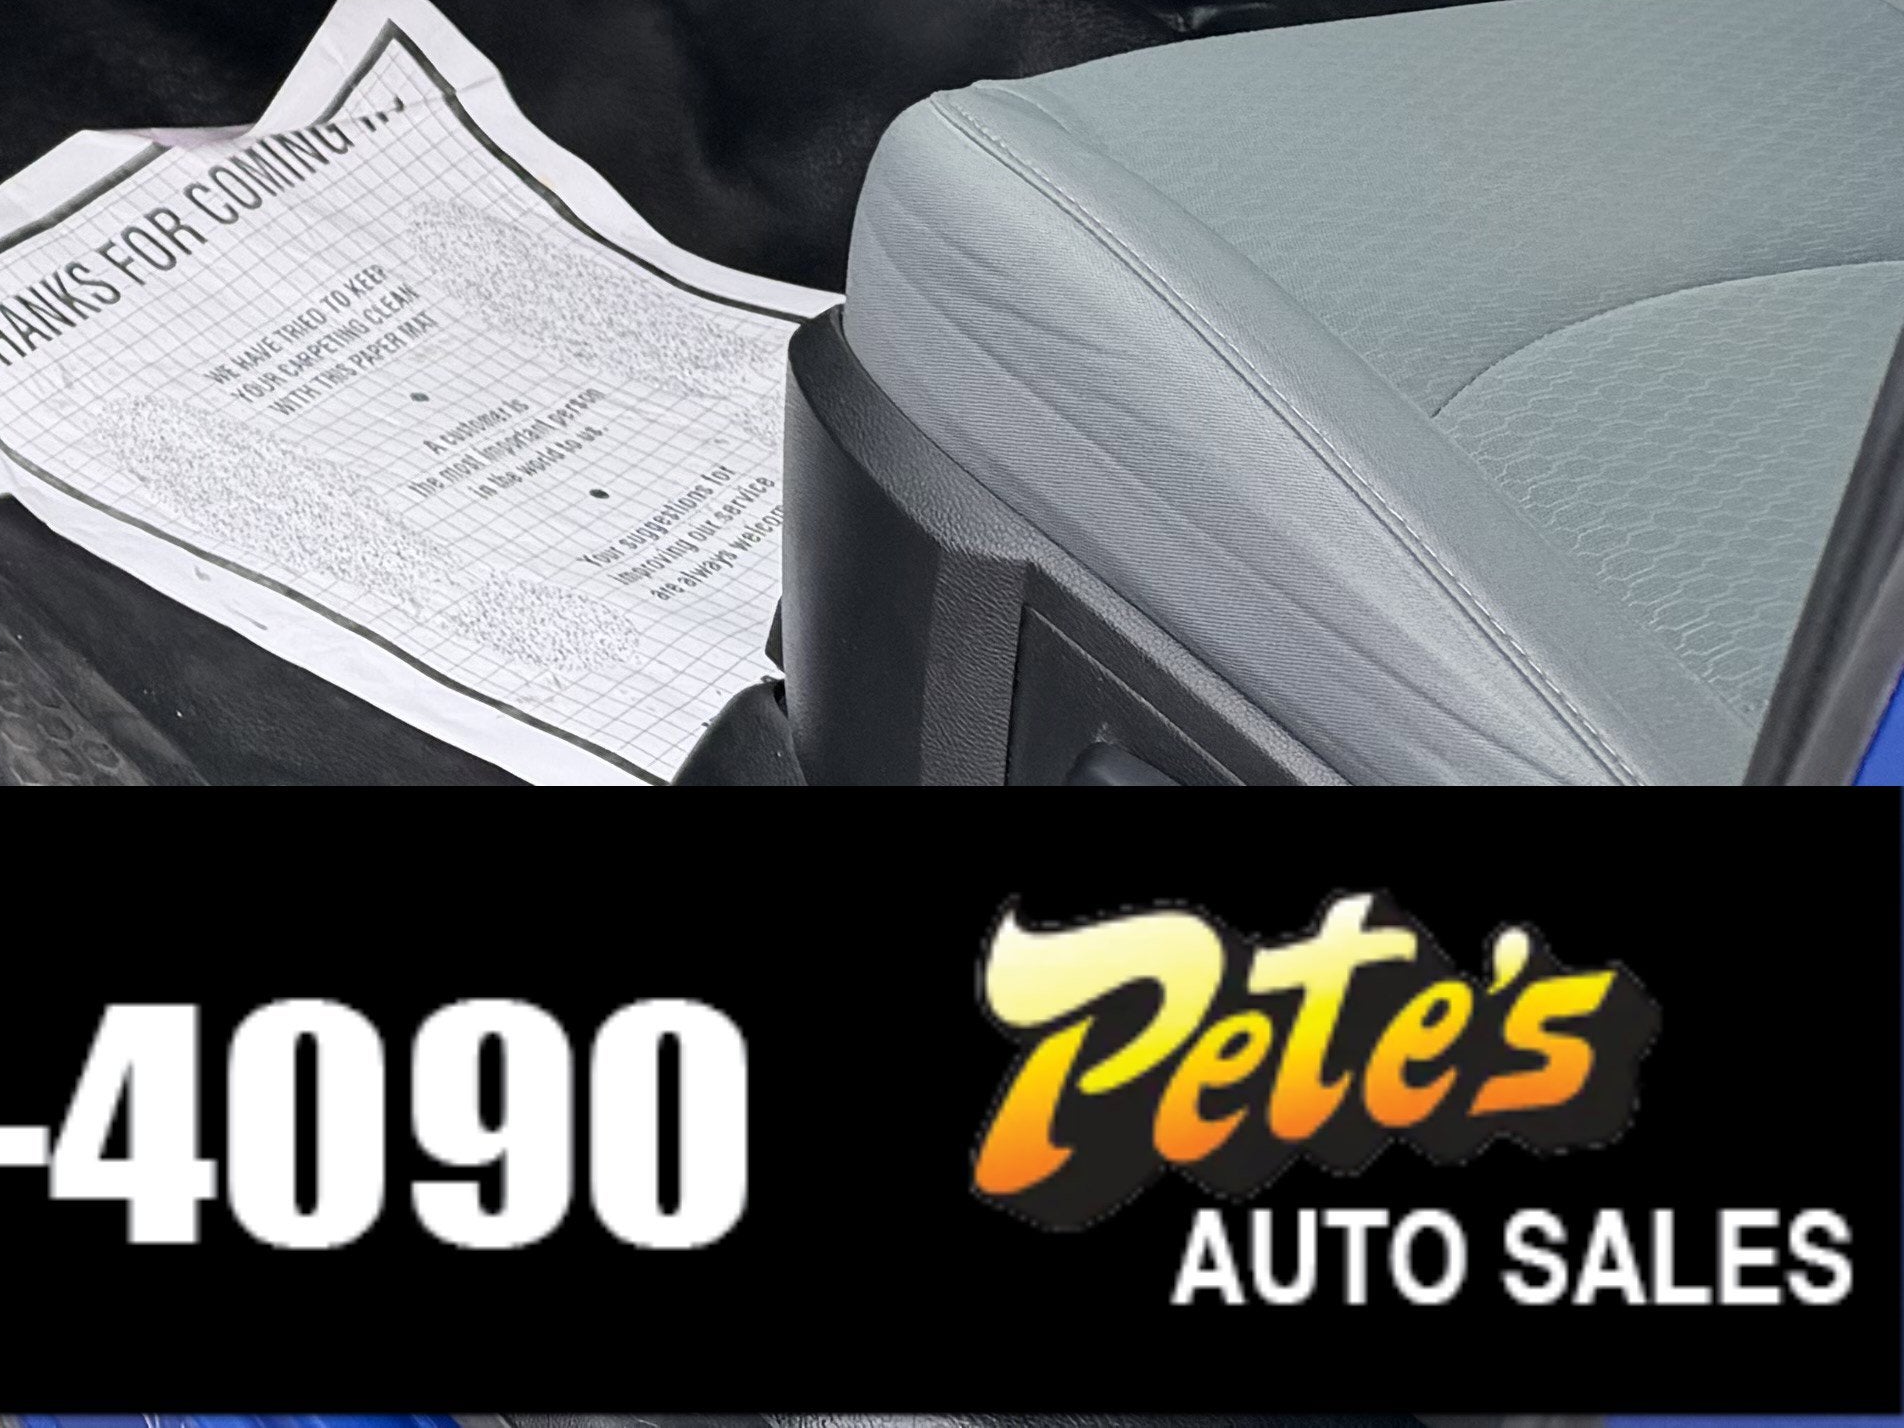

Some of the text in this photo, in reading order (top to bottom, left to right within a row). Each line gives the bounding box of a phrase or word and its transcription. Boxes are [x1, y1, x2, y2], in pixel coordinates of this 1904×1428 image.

[97, 207, 208, 287] FOR
[184, 124, 353, 225] COMING
[204, 264, 387, 385] WE HAVE TRIED TO KEEP
[231, 282, 420, 403] YOUR CARPETING CLEAN
[268, 310, 438, 416] WITH THIS PAPER MAT
[408, 388, 605, 498] the most important person
[423, 399, 529, 455] A customer is
[467, 484, 498, 499] in
[487, 471, 522, 488] the
[516, 447, 565, 477] world
[555, 439, 582, 453] to
[577, 465, 736, 568] Your suggestions for
[650, 504, 784, 600] are always welcom
[688, 519, 722, 542] our
[714, 477, 775, 523] service
